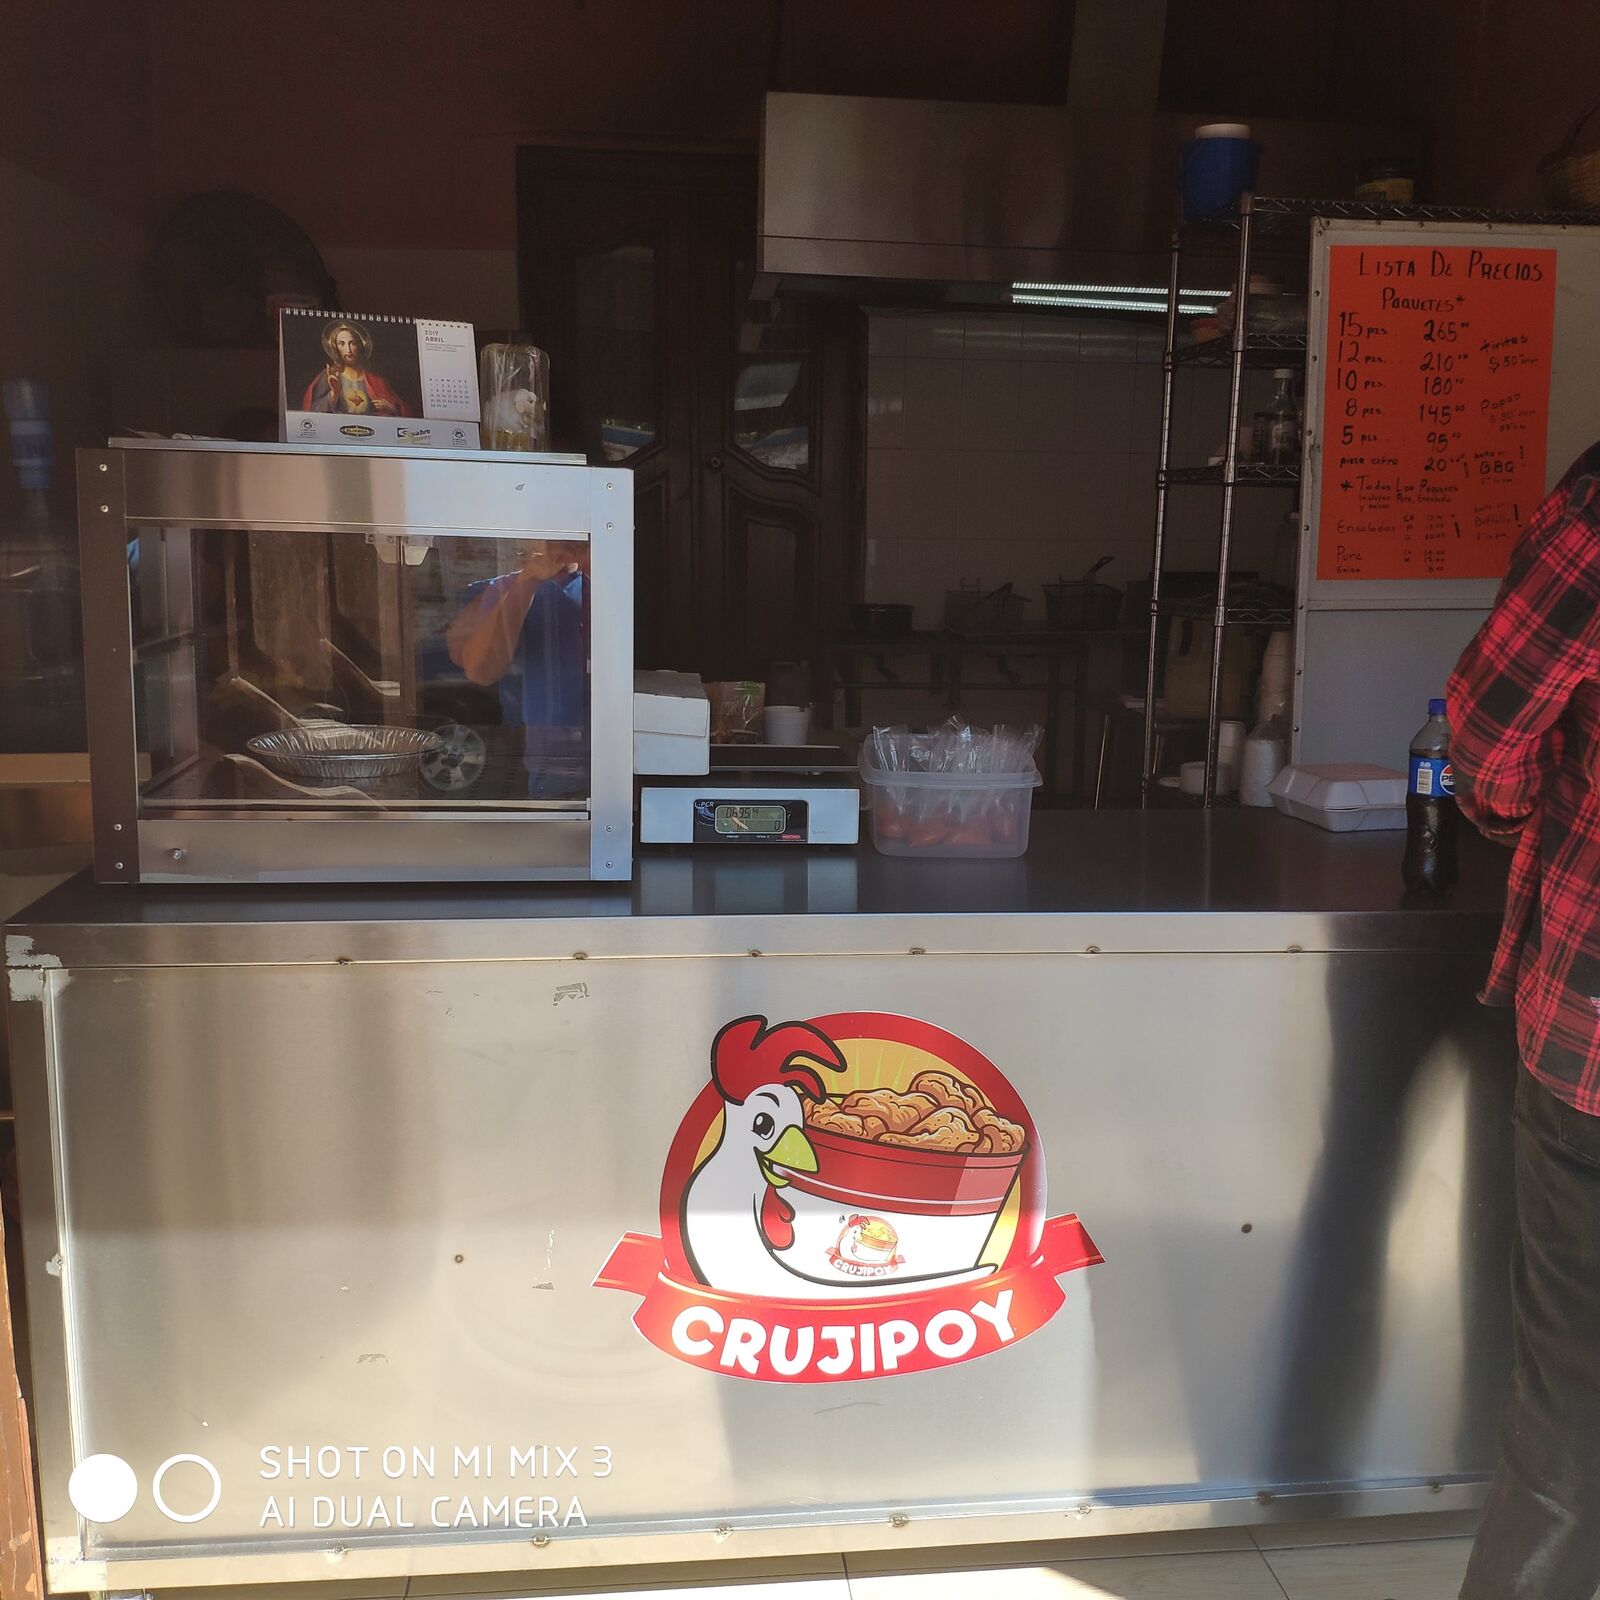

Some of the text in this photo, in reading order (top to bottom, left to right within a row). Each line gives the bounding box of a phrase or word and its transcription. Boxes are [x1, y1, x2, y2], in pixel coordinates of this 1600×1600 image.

[1359, 251, 1416, 278] LISTA
[1467, 249, 1543, 282] PRECIOS
[1339, 311, 1364, 338] 15
[1337, 340, 1361, 364] 12
[1336, 367, 1358, 392] 10
[1345, 397, 1358, 417] 8
[1342, 424, 1355, 445] 5
[833, 1258, 894, 1276] CRUJIPOY
[671, 1289, 1015, 1376] CRUJIPOY
